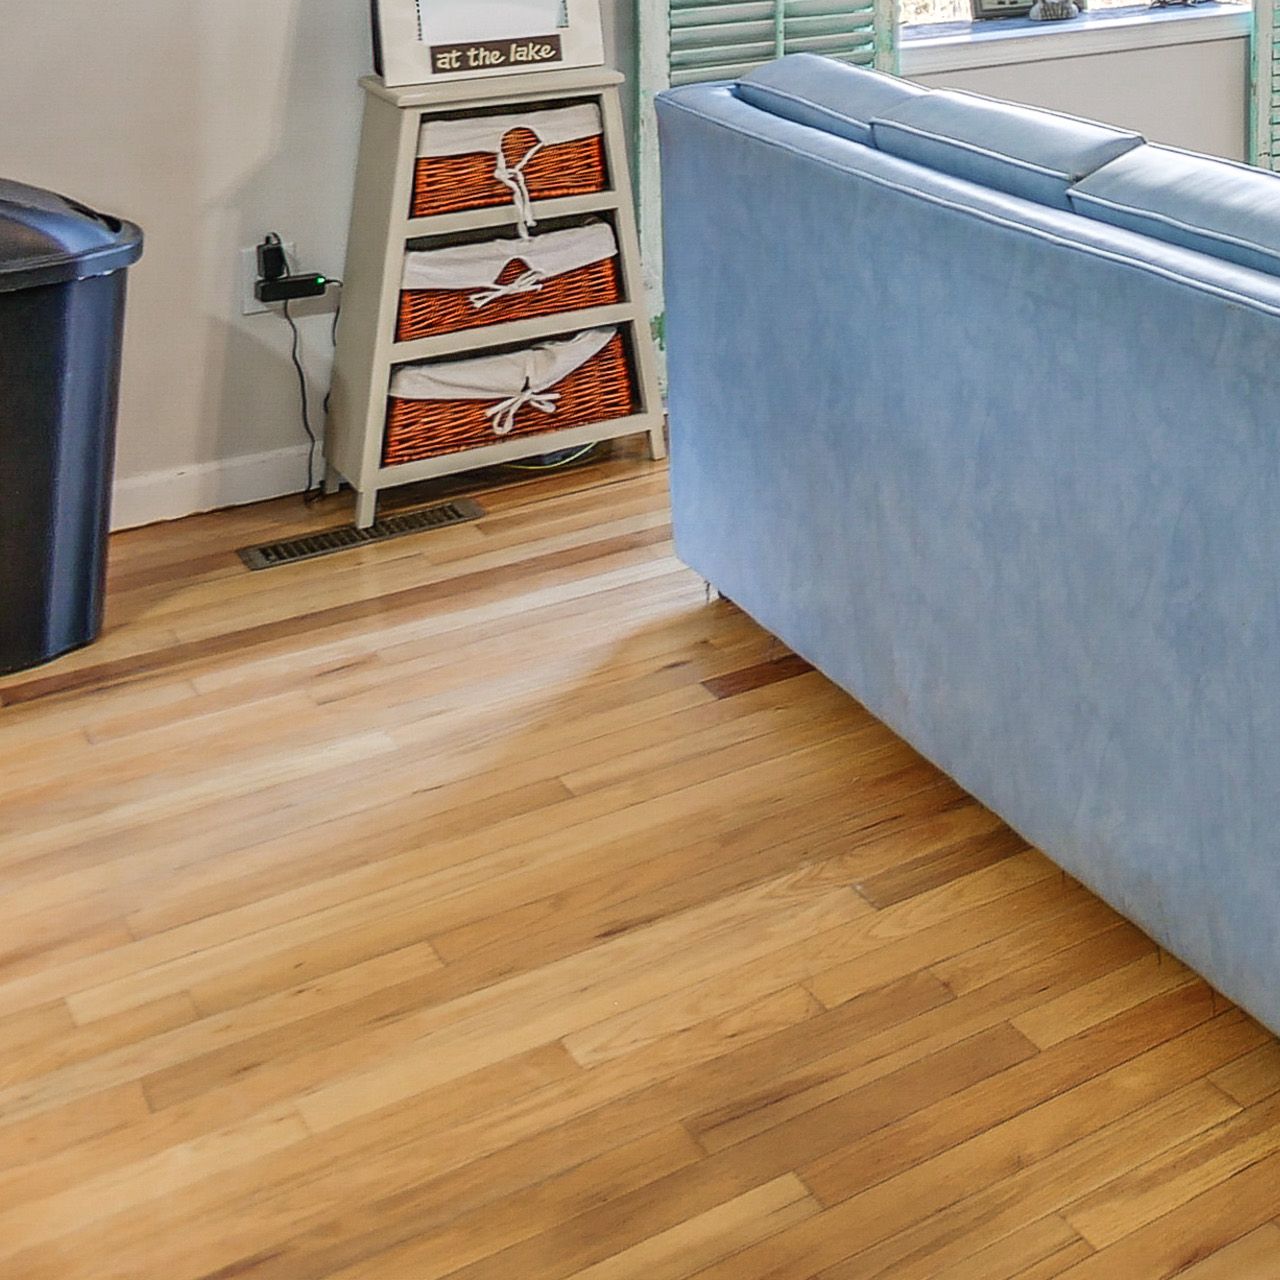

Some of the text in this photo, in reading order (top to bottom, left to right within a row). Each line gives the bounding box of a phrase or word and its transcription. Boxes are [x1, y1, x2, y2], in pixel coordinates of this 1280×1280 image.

[436, 42, 556, 70] at the lake
